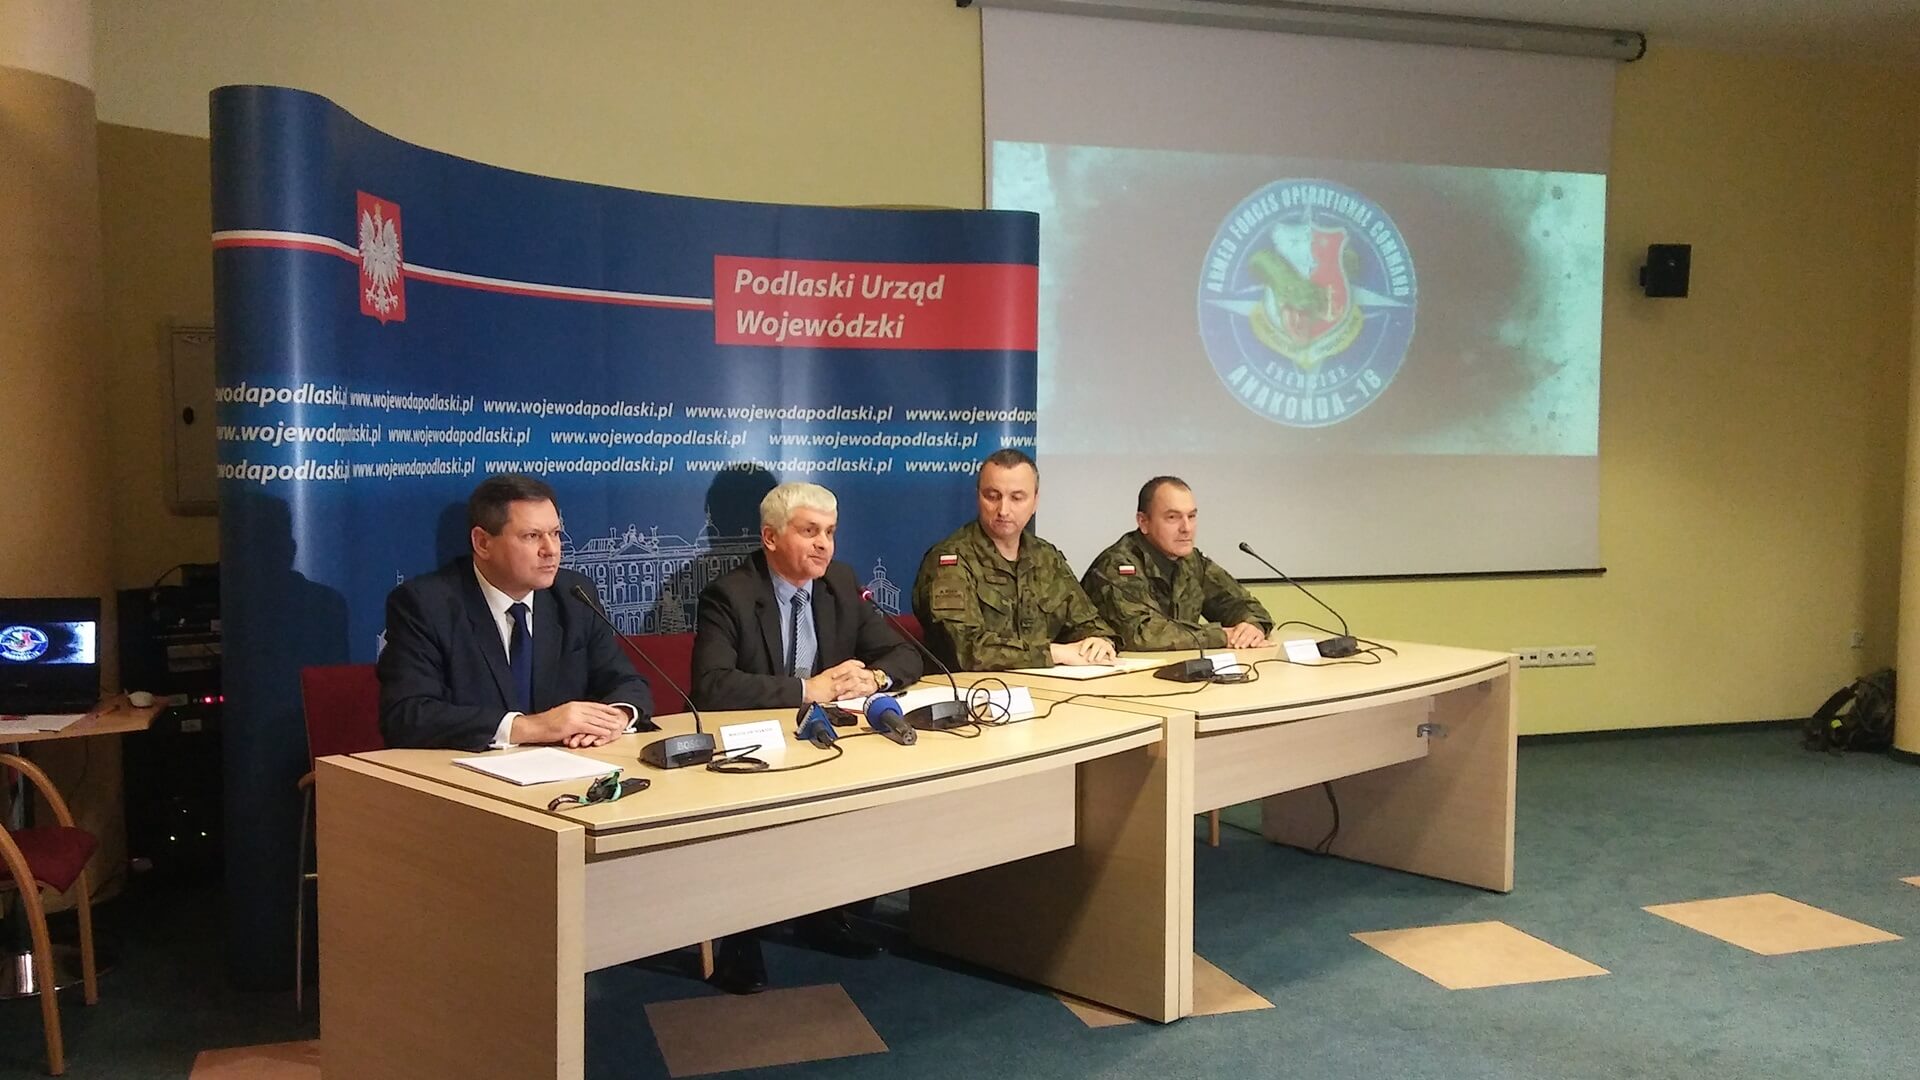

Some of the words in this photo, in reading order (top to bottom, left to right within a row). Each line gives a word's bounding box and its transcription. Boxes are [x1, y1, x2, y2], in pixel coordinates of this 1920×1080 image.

[1206, 239, 1237, 293] ARMED
[1229, 192, 1280, 240] FORCES
[1281, 185, 1373, 228] OPERATIONAL
[1369, 220, 1410, 297] COMMAND
[734, 268, 854, 298] Podlaski
[861, 274, 945, 306] Urząd
[736, 309, 905, 342] Wojewódzki
[350, 389, 474, 416] www.wojewodapodlaski.pl
[483, 399, 674, 420] www.wojewodapodlaski.pl
[685, 404, 893, 424] www.wojewodapodlaski.pl
[1227, 364, 1382, 421] ANAKONDA-16
[388, 424, 531, 447] www.wojewodapodlaski.pl
[551, 429, 747, 448] www.wojewodapodlaski.pl
[769, 432, 978, 450] www.wojewodapodlaski.pl
[353, 456, 475, 481] www.wojewodapodlaski.pl
[485, 456, 674, 476] www.wojewodapodlaski.pl
[686, 457, 893, 475] www.wojewodapodlaski.pl
[677, 738, 708, 751] BOSC
